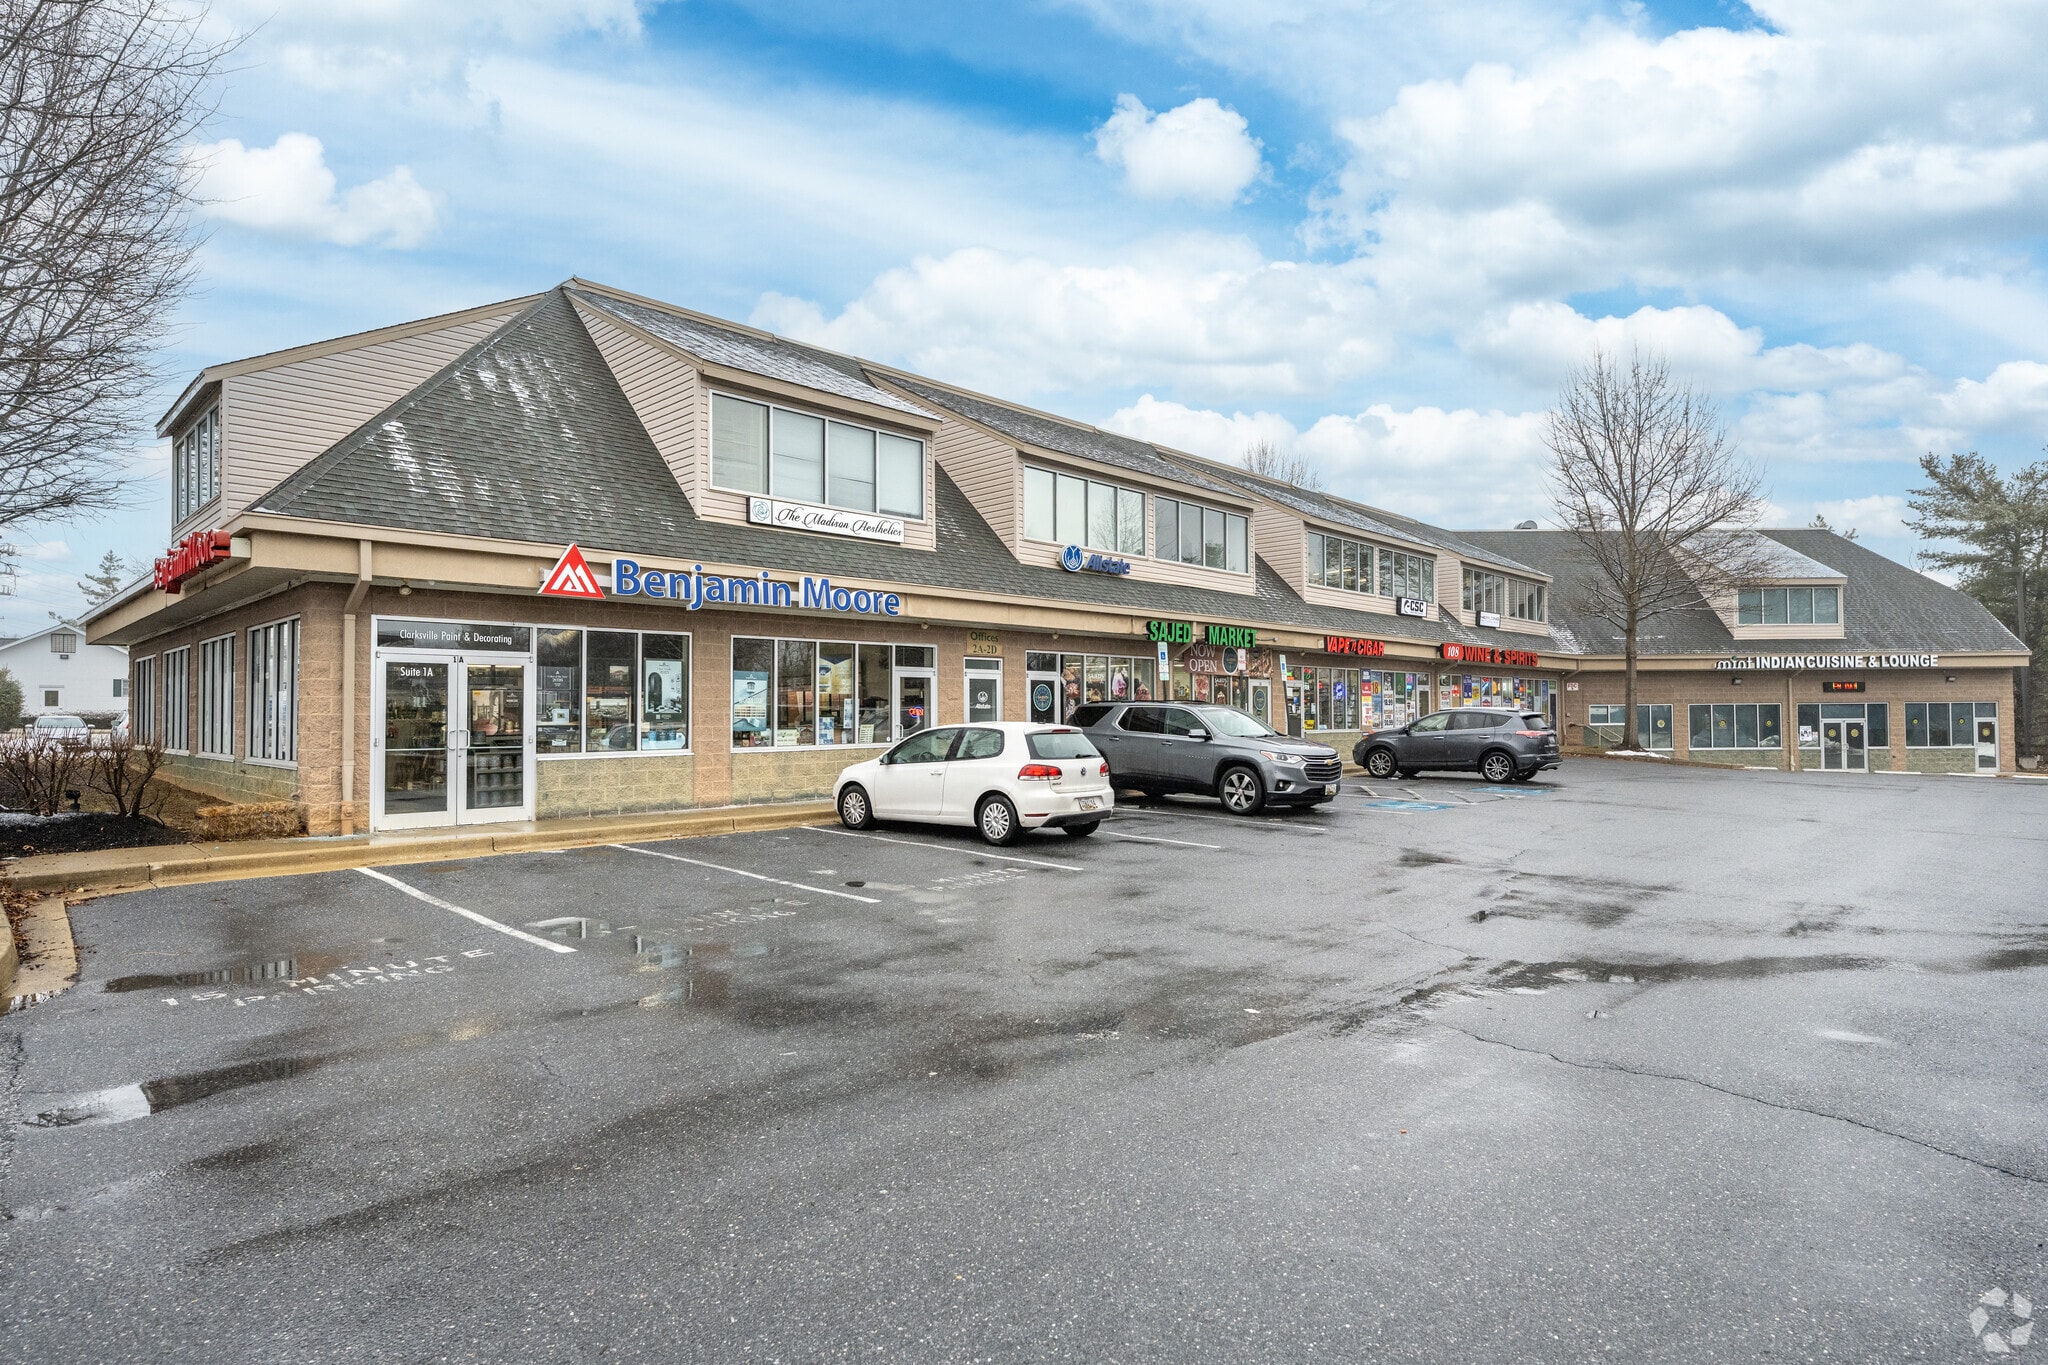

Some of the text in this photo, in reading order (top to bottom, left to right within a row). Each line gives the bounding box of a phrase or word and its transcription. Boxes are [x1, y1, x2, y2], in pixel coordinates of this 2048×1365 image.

[775, 506, 804, 523] The
[801, 512, 849, 529] Madison
[1086, 554, 1131, 575] Allstate
[613, 558, 901, 616] Benjamin Moore
[400, 629, 512, 645] Clarksville Paint & Decorating
[970, 631, 999, 643] Offices
[1150, 620, 1258, 648] SAJED MARKET
[972, 643, 998, 655] 2A-2D
[1190, 644, 1216, 658] NOW
[1326, 636, 1350, 654] VAPE
[1357, 639, 1385, 657] CIGAR
[1447, 646, 1538, 667] 108 WINE & SPIRITS
[1755, 656, 1805, 669] INDIAN
[1805, 655, 1864, 668] CUISINE
[1867, 656, 1878, 668] &
[1880, 654, 1939, 668] LOUNGE
[400, 667, 433, 677] Suite 1A
[1189, 658, 1217, 673] OPEN
